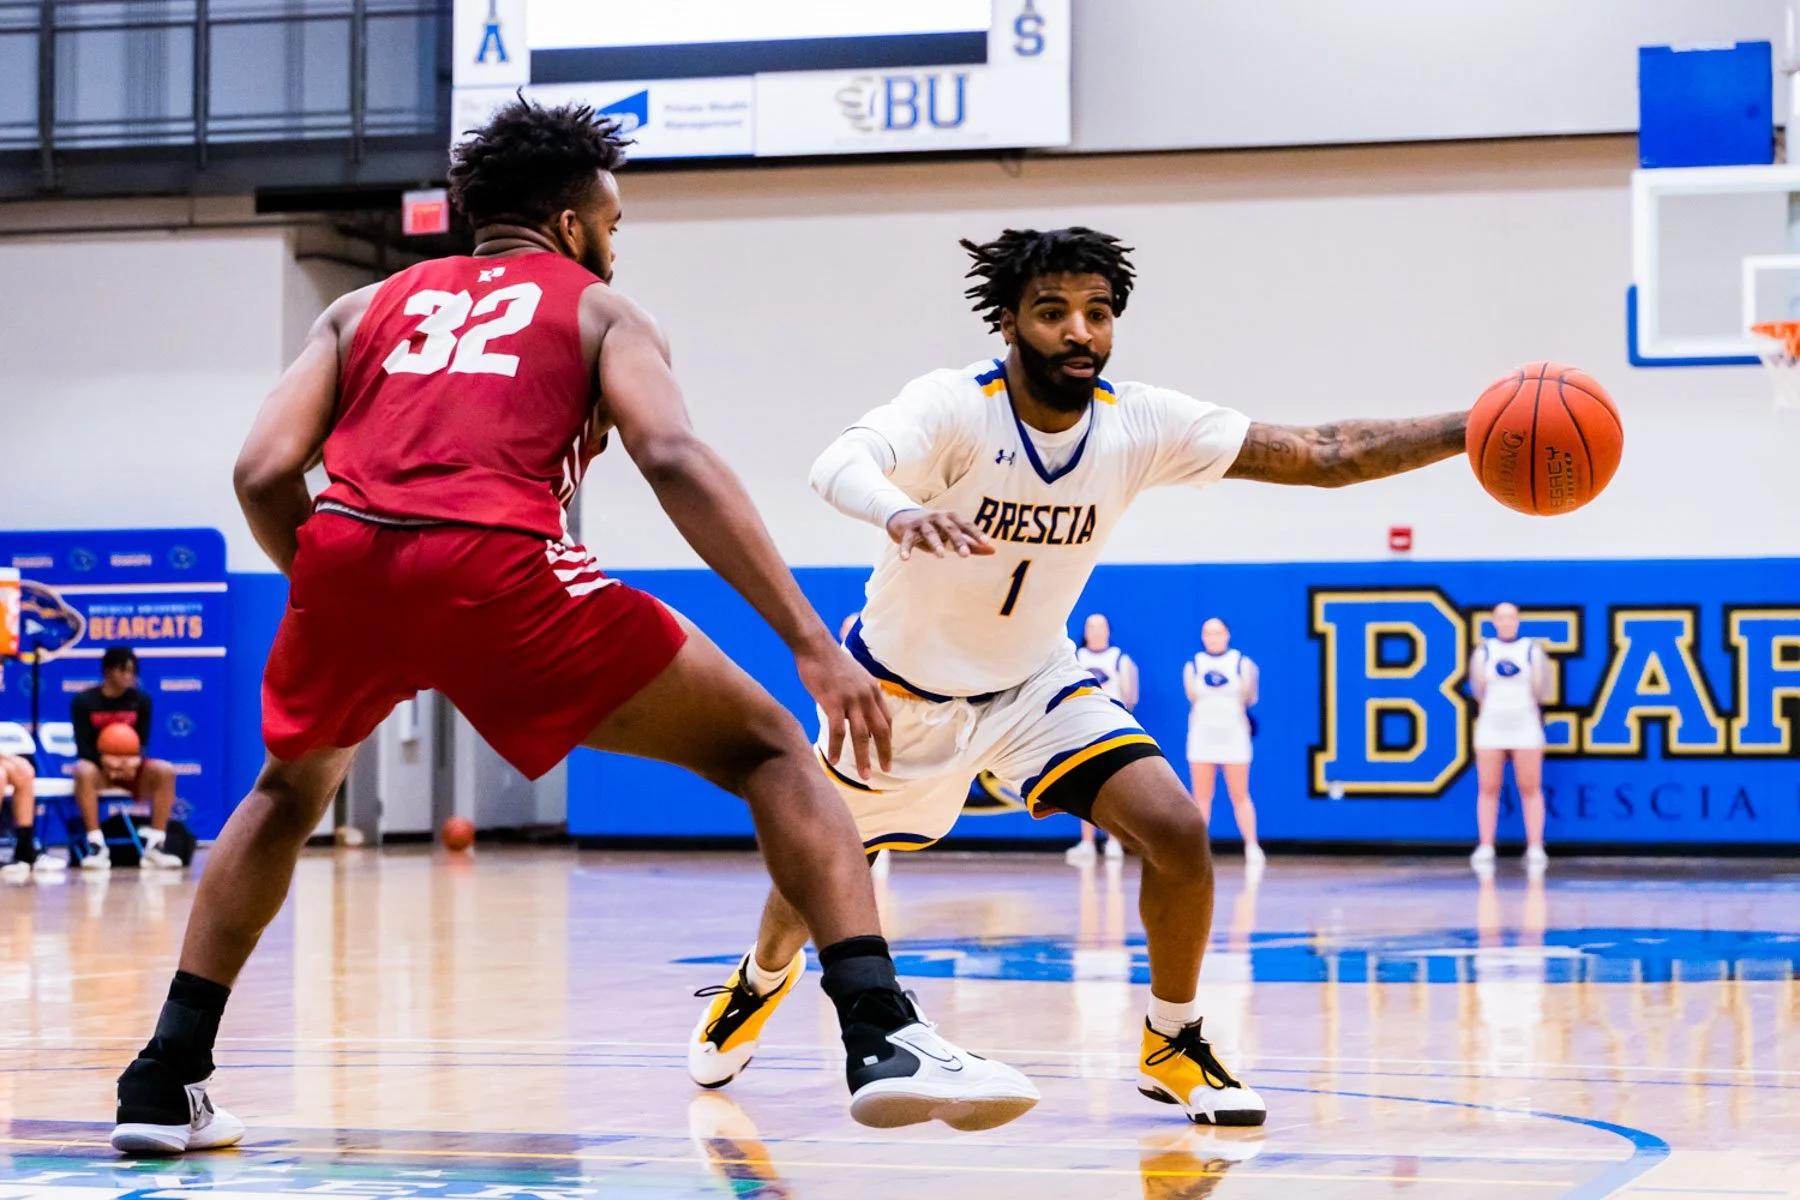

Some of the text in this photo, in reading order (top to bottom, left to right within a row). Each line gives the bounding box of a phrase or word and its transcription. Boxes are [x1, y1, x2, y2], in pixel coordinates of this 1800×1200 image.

[881, 73, 971, 132] BU
[382, 282, 543, 378] 32
[974, 496, 1097, 545] BRESCIA
[998, 558, 1033, 617] 1
[89, 615, 203, 640] BEARCATS
